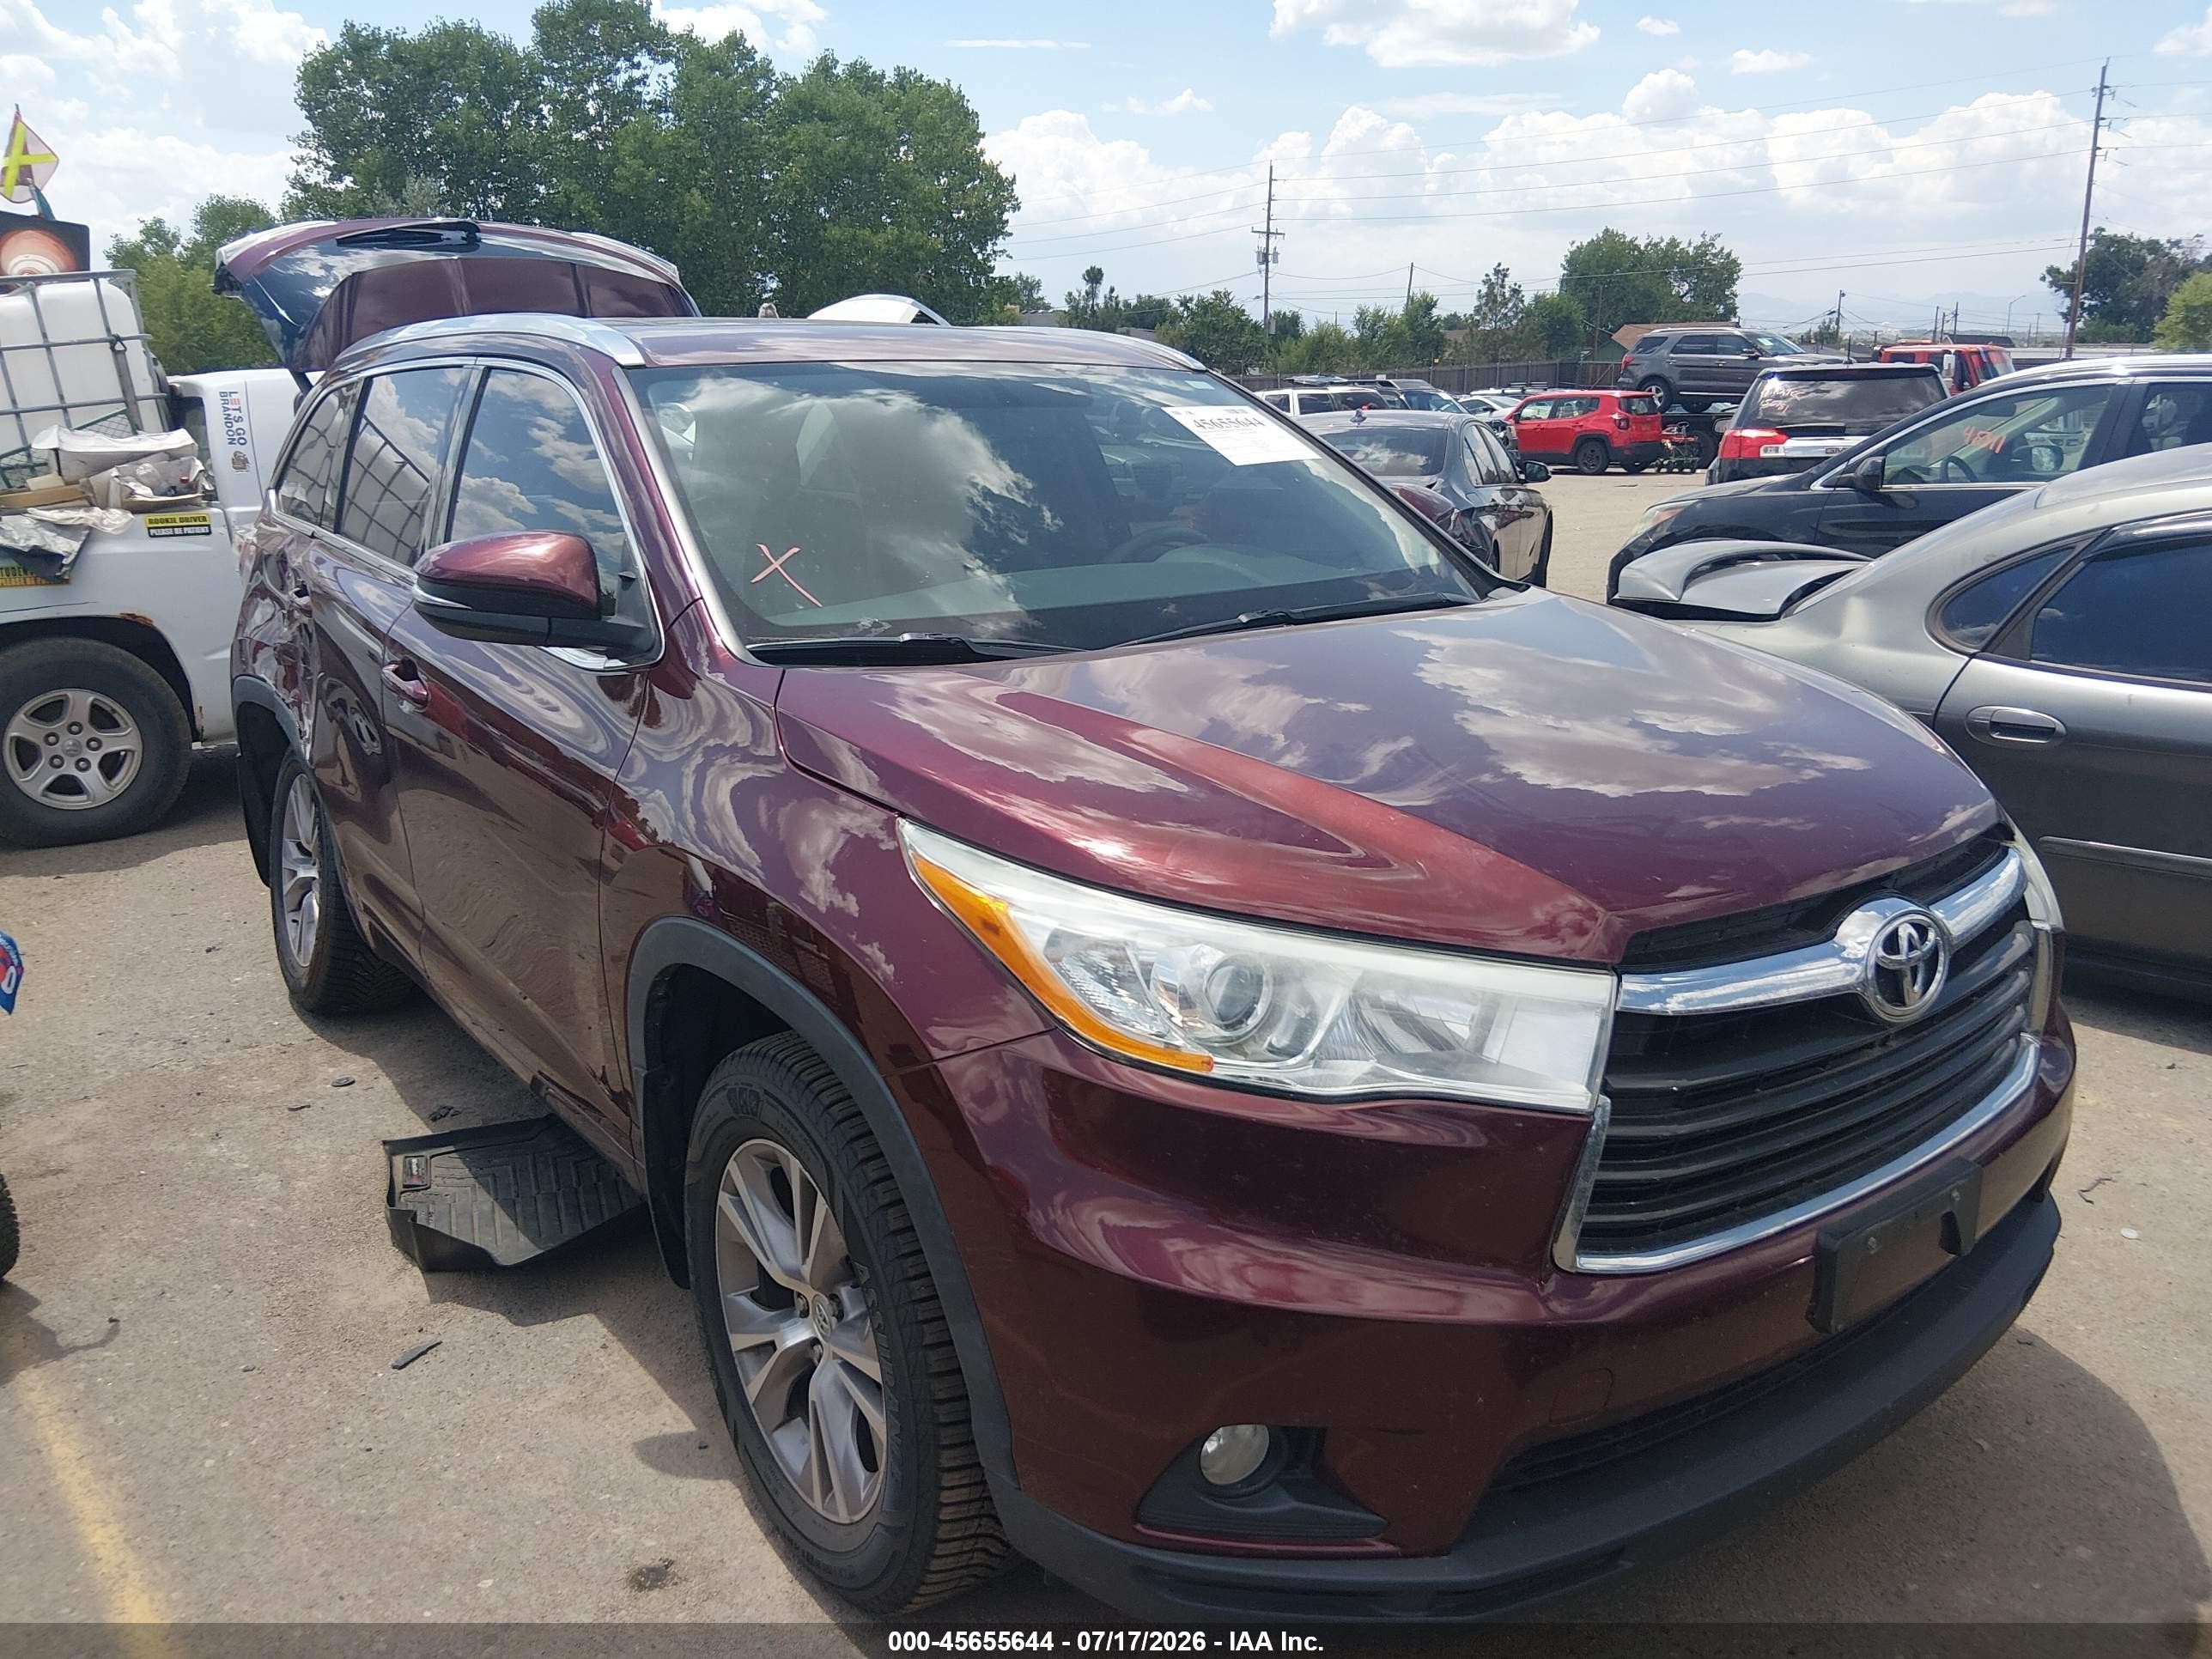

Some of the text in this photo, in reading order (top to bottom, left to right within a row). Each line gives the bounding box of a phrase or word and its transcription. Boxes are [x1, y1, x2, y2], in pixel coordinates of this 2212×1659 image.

[219, 392, 237, 446] BRANDON
[1193, 417, 1266, 430] 45655644
[235, 428, 247, 446] GO
